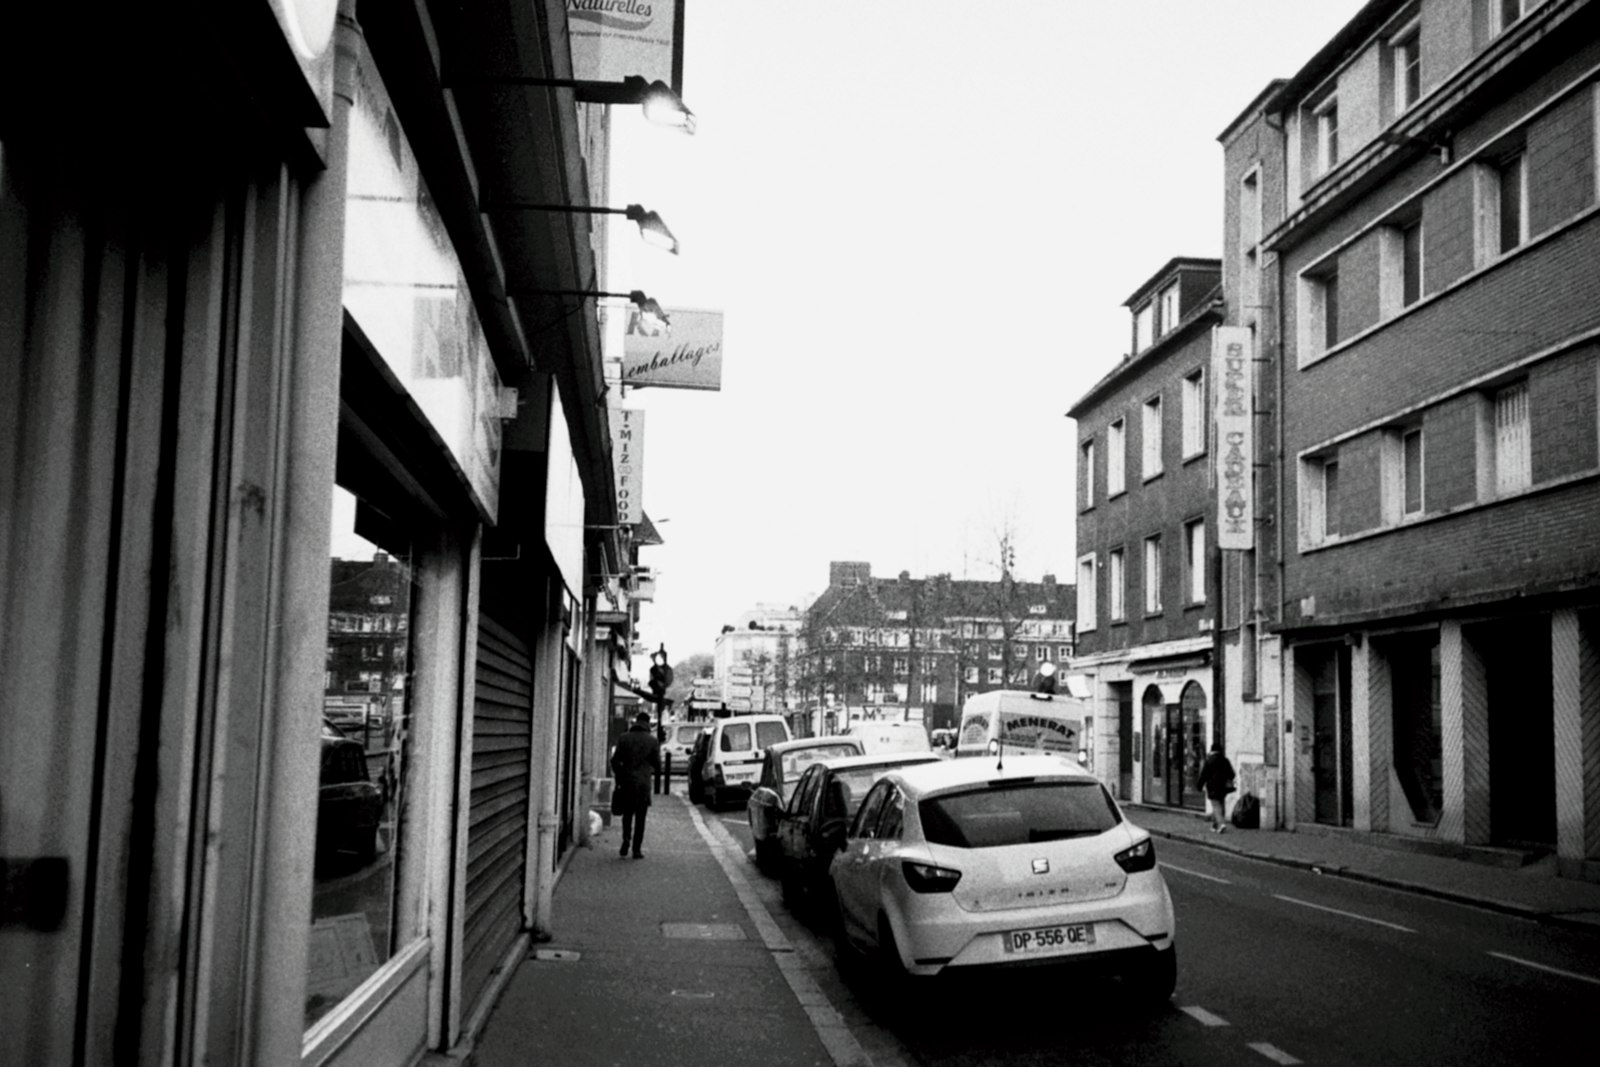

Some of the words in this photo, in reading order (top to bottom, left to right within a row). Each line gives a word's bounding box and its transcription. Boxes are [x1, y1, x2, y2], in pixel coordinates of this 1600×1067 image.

[628, 342, 720, 378] emballages
[618, 475, 630, 520] FOOD
[1006, 717, 1076, 739] MENERAT
